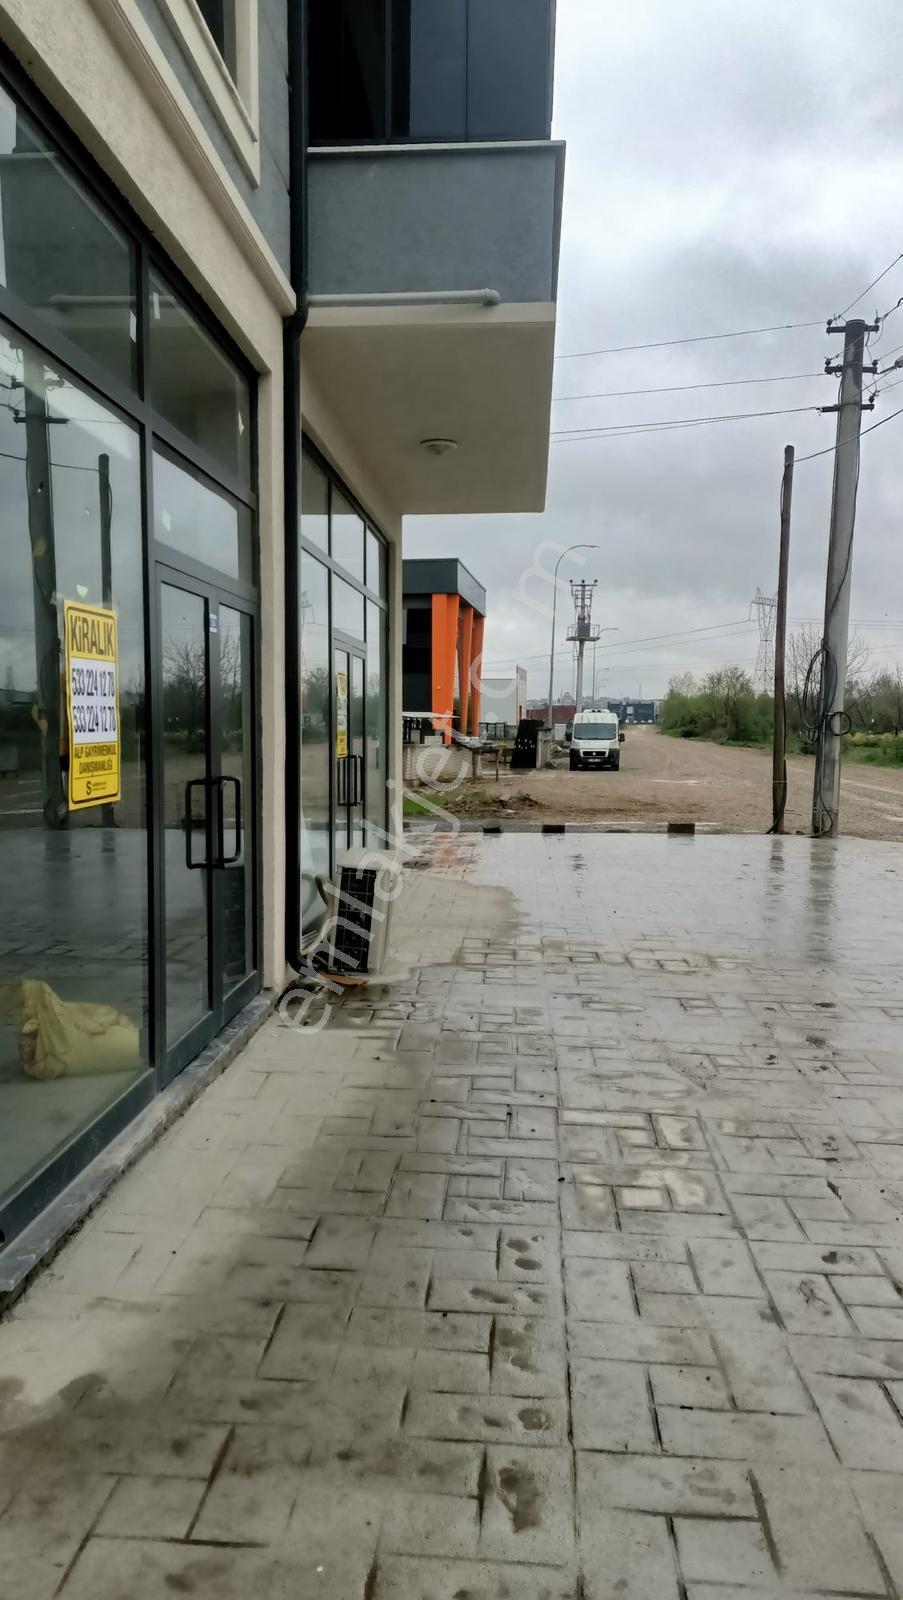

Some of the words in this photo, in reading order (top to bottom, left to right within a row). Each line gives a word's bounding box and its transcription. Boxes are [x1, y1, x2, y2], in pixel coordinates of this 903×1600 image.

[72, 668, 85, 696] 533
[86, 669, 98, 696] 224
[99, 670, 107, 697] 12
[73, 705, 87, 733] 533
[87, 705, 99, 733] 224
[100, 705, 108, 732] 12
